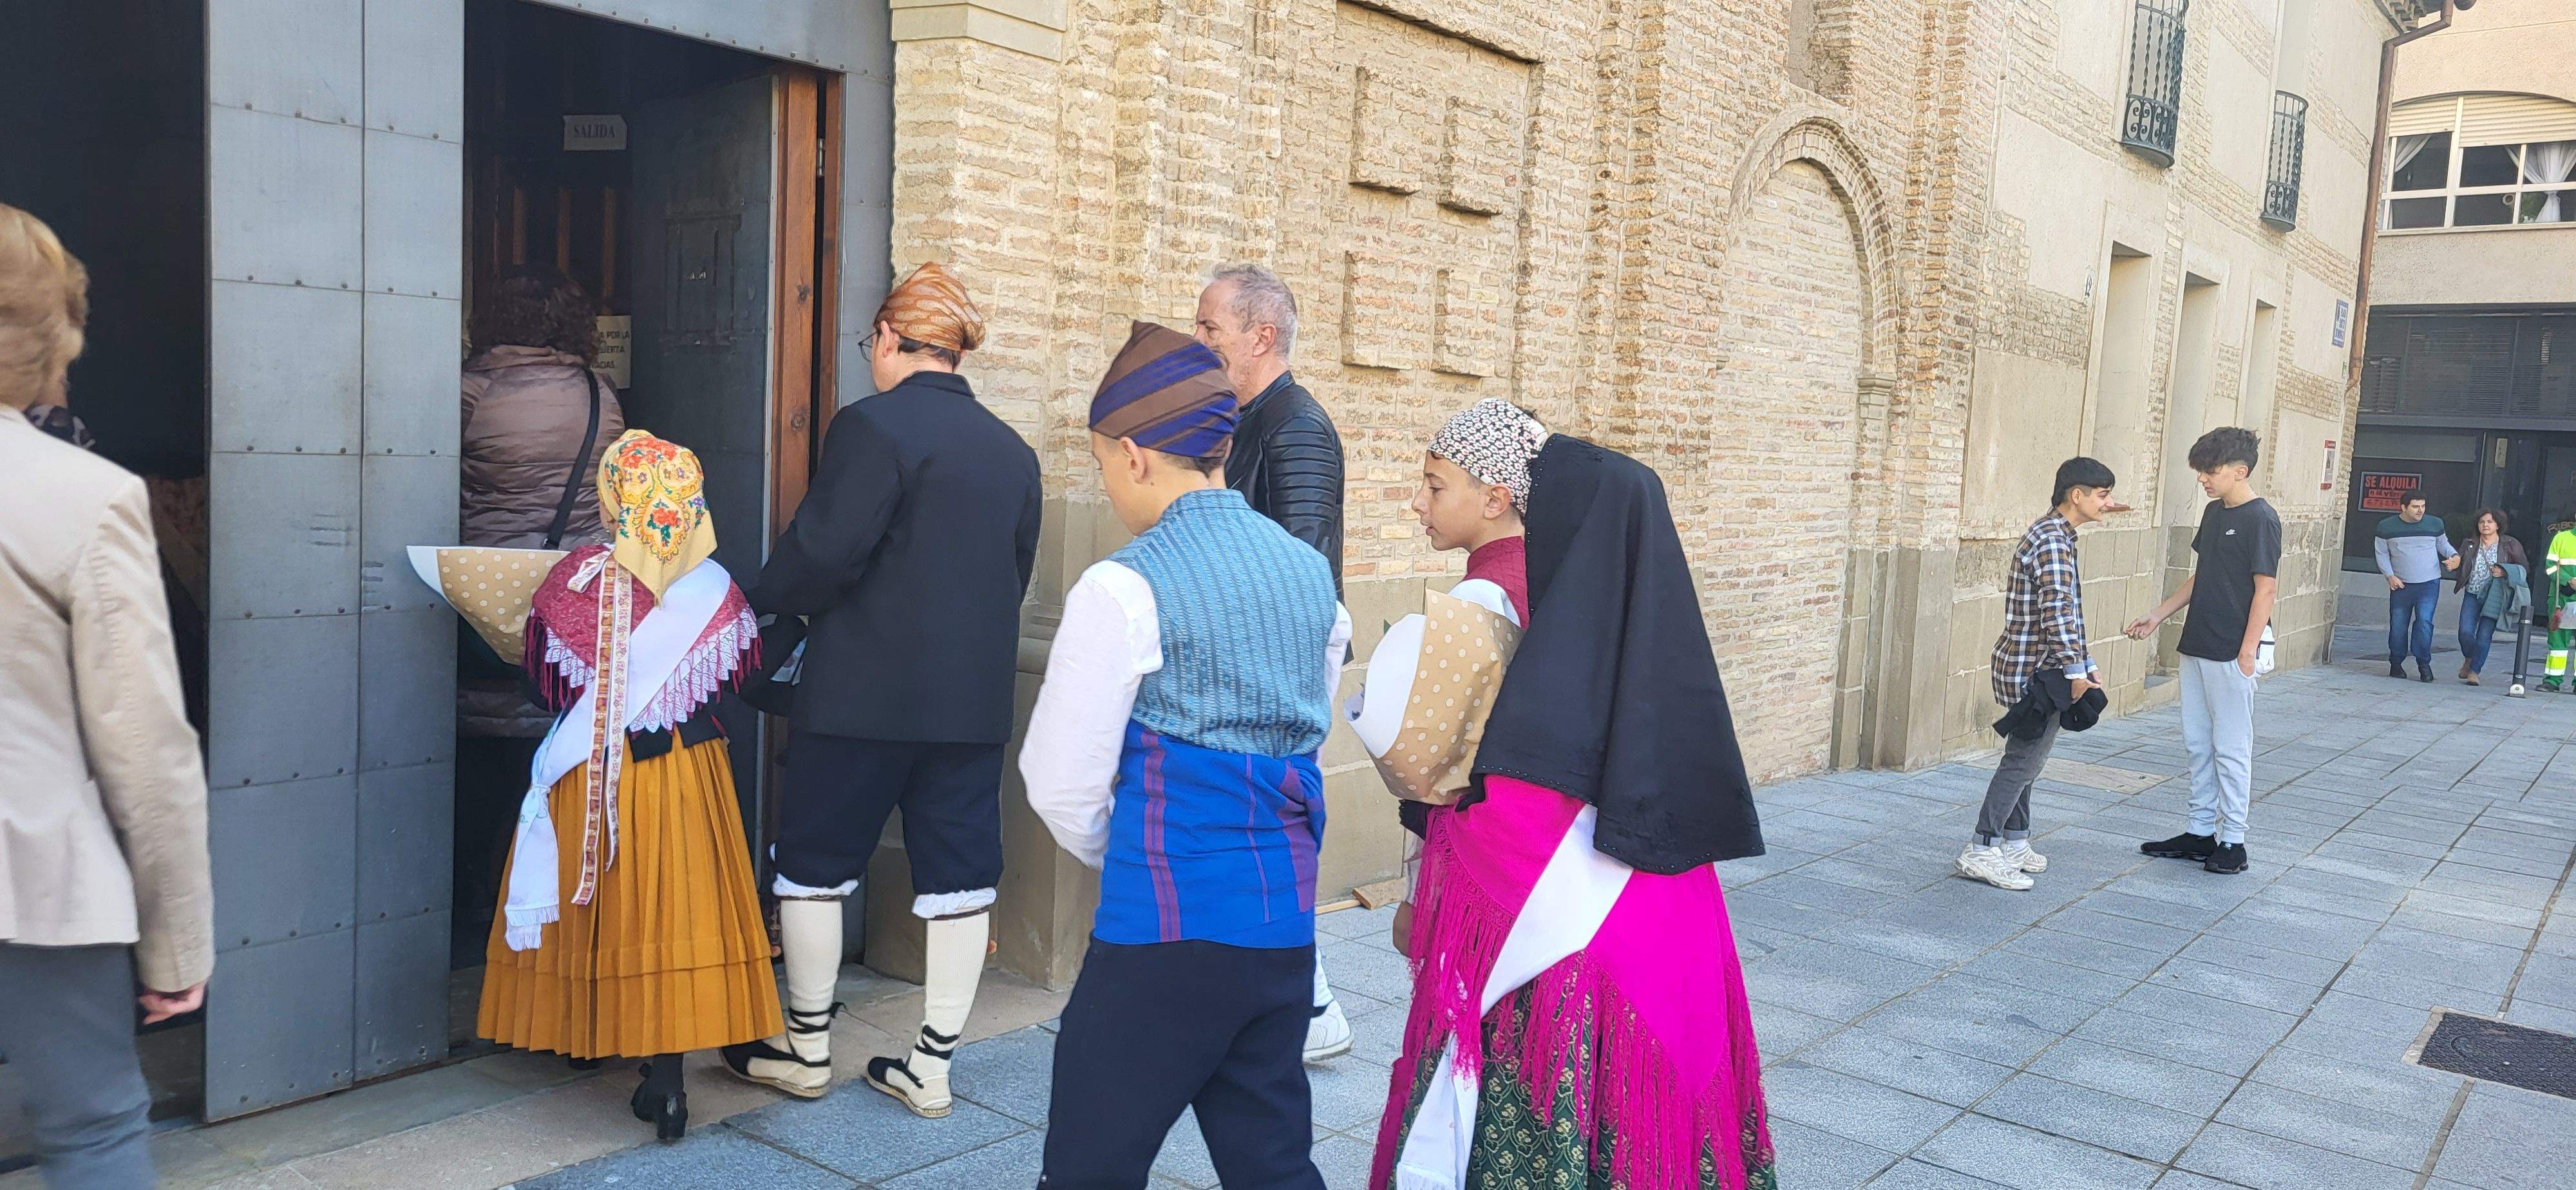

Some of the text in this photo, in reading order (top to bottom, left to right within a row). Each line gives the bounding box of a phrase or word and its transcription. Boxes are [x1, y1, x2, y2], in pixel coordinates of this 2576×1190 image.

[573, 124, 616, 138] SALIDA
[2365, 476, 2417, 489] SE ALQUILA
